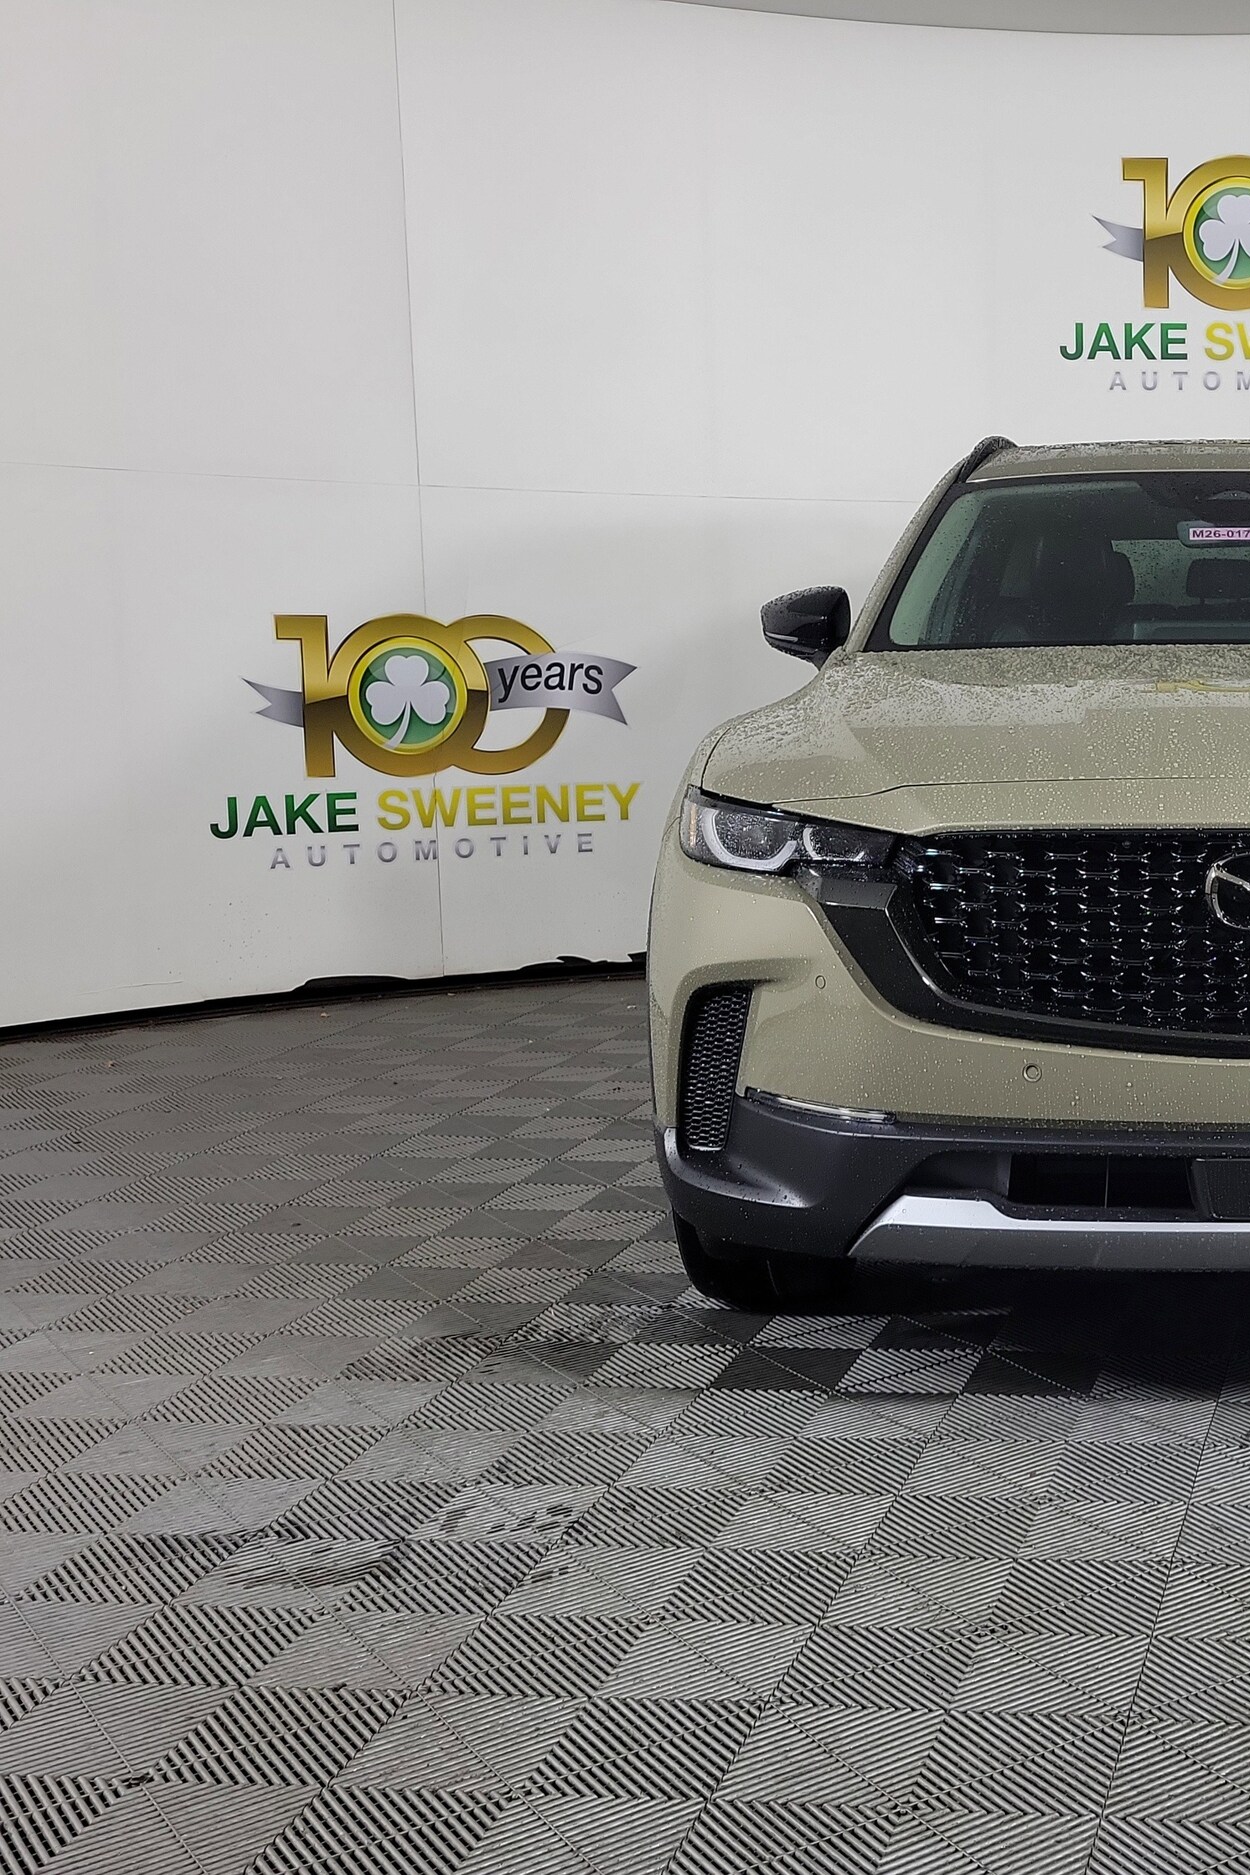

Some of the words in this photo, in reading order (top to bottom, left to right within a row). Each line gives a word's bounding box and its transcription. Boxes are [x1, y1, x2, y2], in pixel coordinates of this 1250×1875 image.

[1059, 322, 1189, 361] JAKE
[1192, 529, 1250, 539] M26-017
[273, 613, 570, 778] 100
[497, 661, 604, 703] years
[209, 791, 360, 839] JAKE
[376, 782, 641, 831] SWEENEY
[270, 832, 595, 870] AUTOMOTIVE
